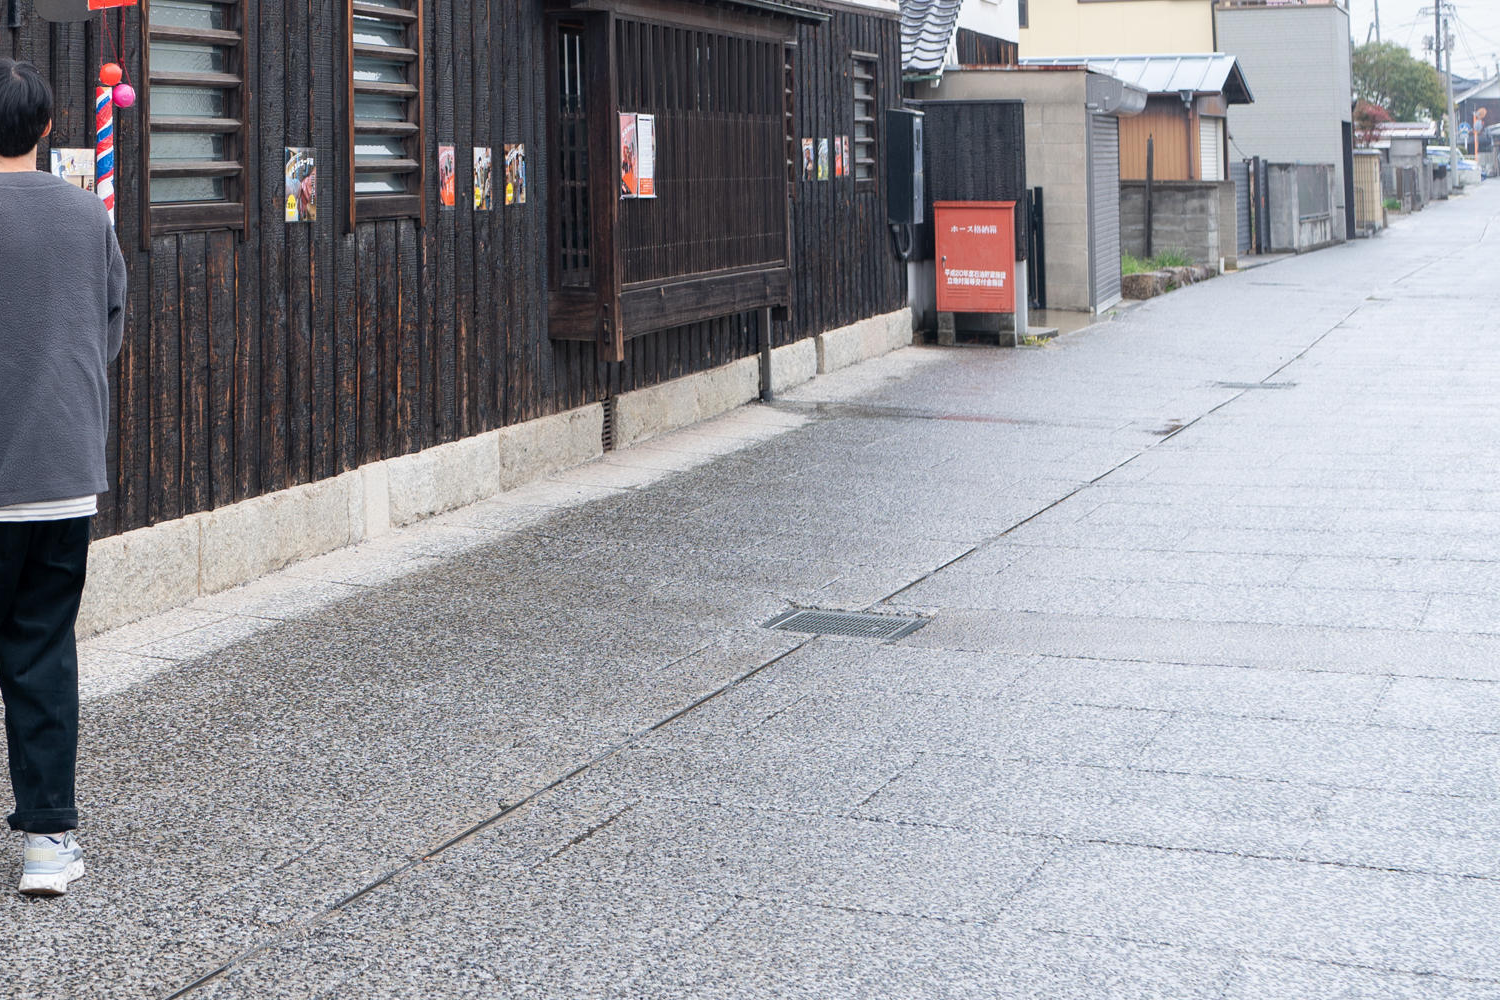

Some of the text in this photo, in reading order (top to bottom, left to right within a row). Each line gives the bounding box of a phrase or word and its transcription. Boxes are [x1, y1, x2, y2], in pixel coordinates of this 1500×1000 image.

[951, 224, 997, 234] ホース格納箱
